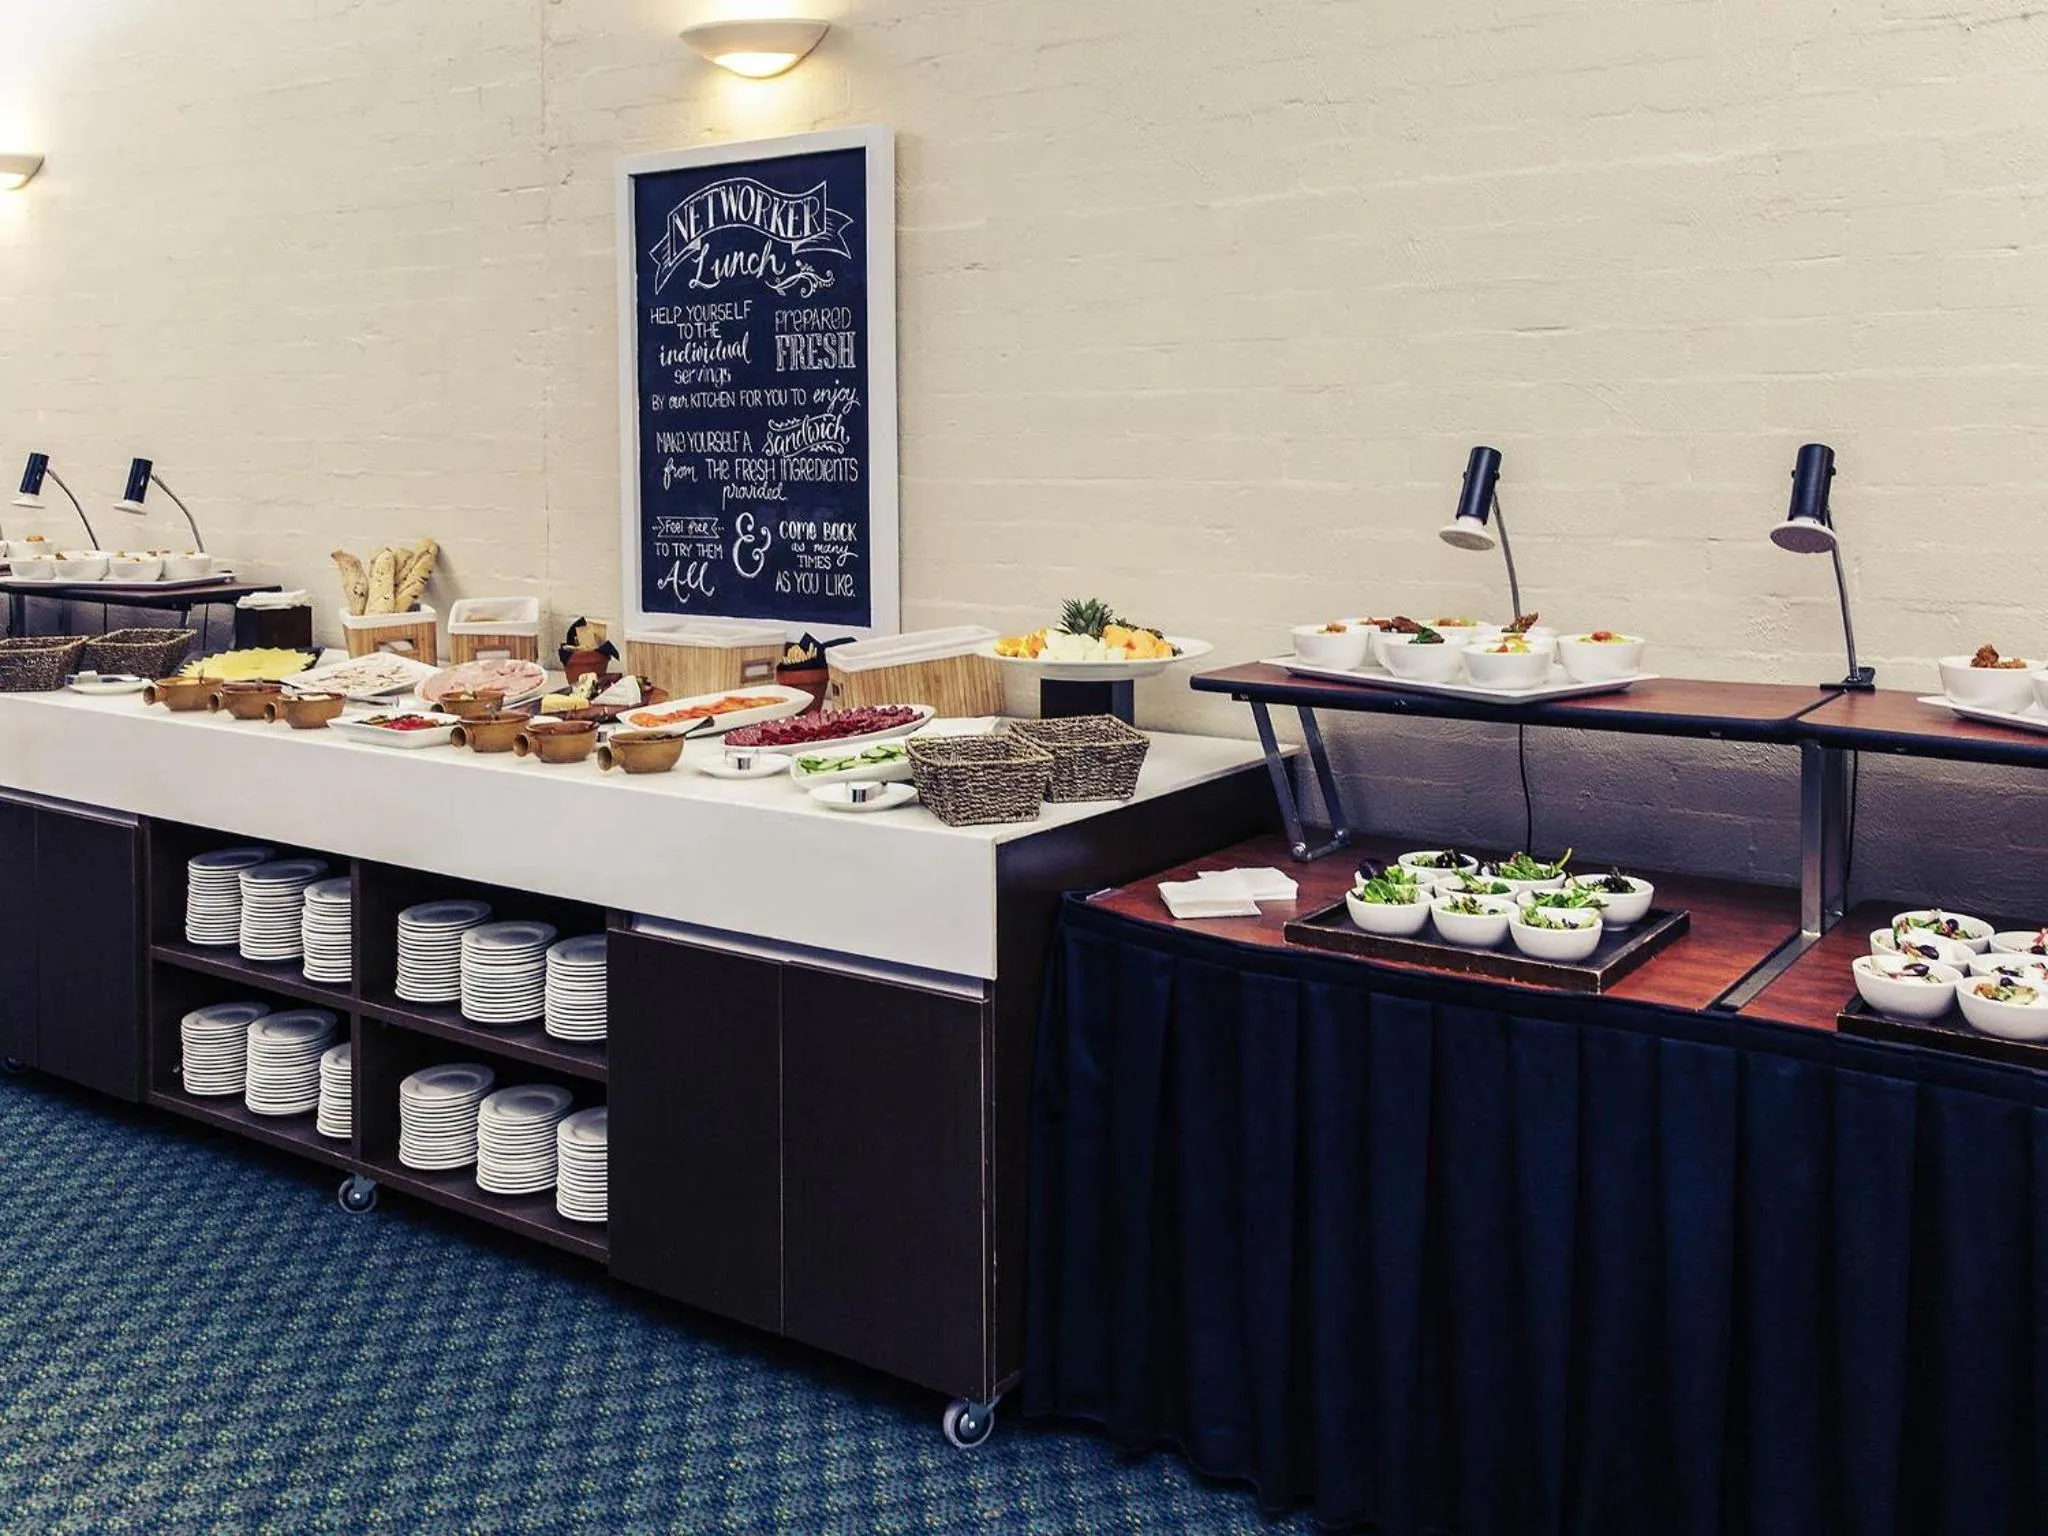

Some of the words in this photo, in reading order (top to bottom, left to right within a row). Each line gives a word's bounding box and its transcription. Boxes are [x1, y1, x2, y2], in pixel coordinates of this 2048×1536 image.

[670, 184, 821, 255] NETWORKER
[688, 240, 786, 289] Lunch
[650, 306, 682, 324] HELP
[686, 300, 752, 322] YOURSELF
[677, 323, 694, 340] TO
[695, 321, 721, 339] THE
[659, 331, 752, 367] individual
[775, 331, 856, 372] FRESH
[674, 365, 731, 388] servings
[652, 394, 665, 410] BY
[669, 394, 690, 409] our
[691, 391, 735, 409] KITCHEN
[740, 389, 762, 408] FOR
[764, 388, 787, 407] YOU
[791, 388, 806, 405] TO
[742, 431, 752, 453] A
[762, 414, 850, 456] sandwich
[663, 458, 698, 490] from
[664, 519, 684, 533] Feel
[654, 542, 670, 557] TO
[671, 542, 692, 557] TRY
[696, 542, 723, 560] THEM
[732, 512, 771, 578] &
[813, 543, 859, 567] many
[796, 554, 831, 569] TIMES
[657, 559, 715, 604] All
[776, 571, 792, 594] AS
[793, 571, 819, 594] YOU
